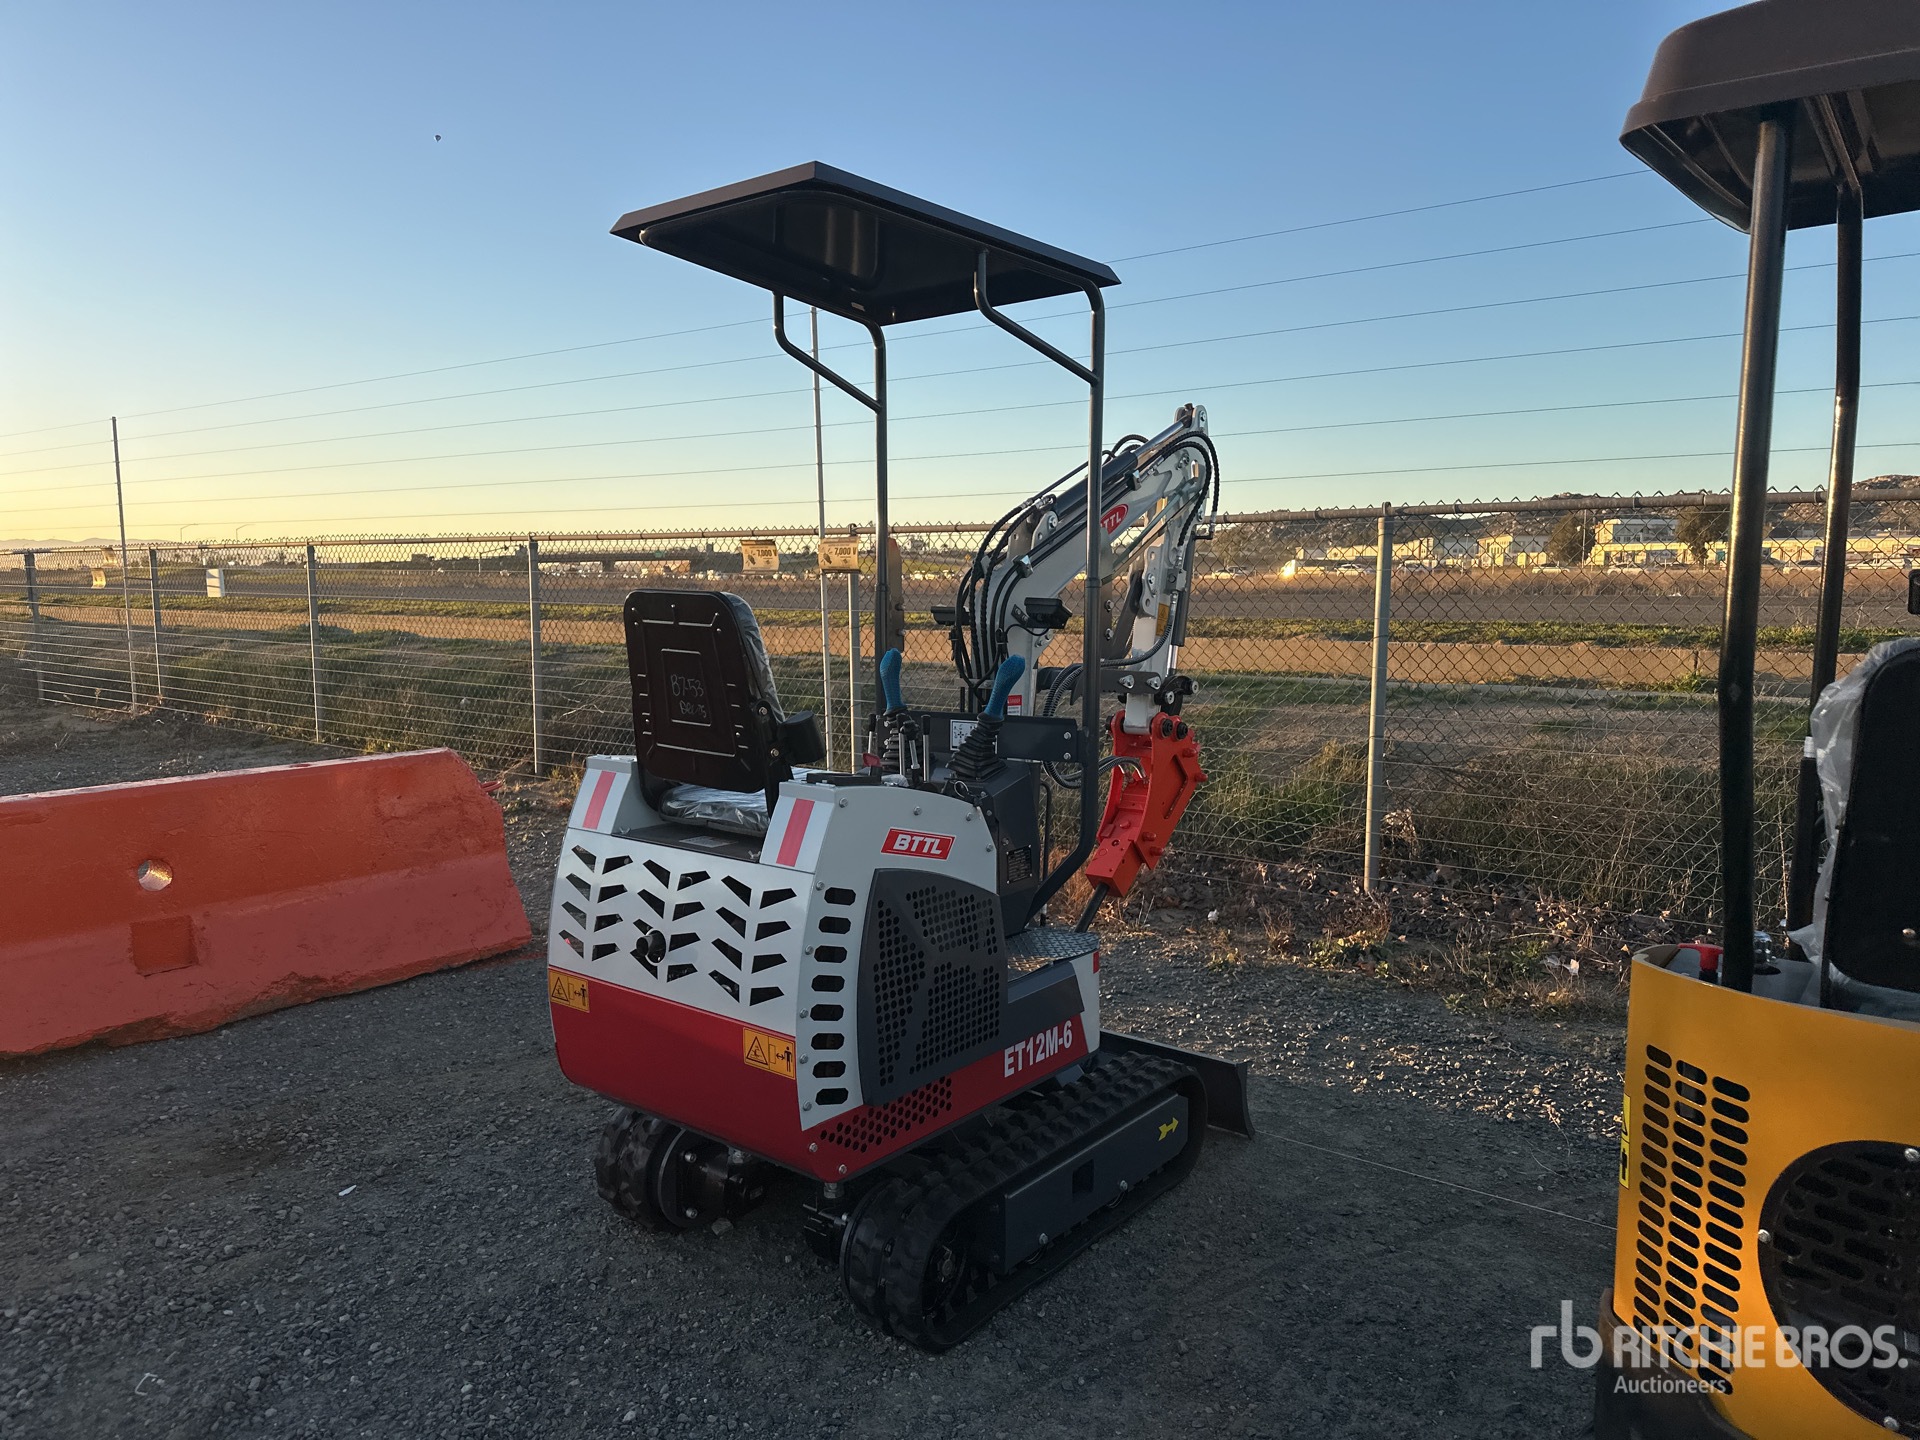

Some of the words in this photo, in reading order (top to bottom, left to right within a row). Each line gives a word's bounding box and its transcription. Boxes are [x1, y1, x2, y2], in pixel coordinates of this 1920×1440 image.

[1100, 511, 1122, 530] TTL
[834, 547, 852, 557] 7,000
[893, 833, 942, 855] BTTL
[1004, 1020, 1073, 1078] ET12M-6
